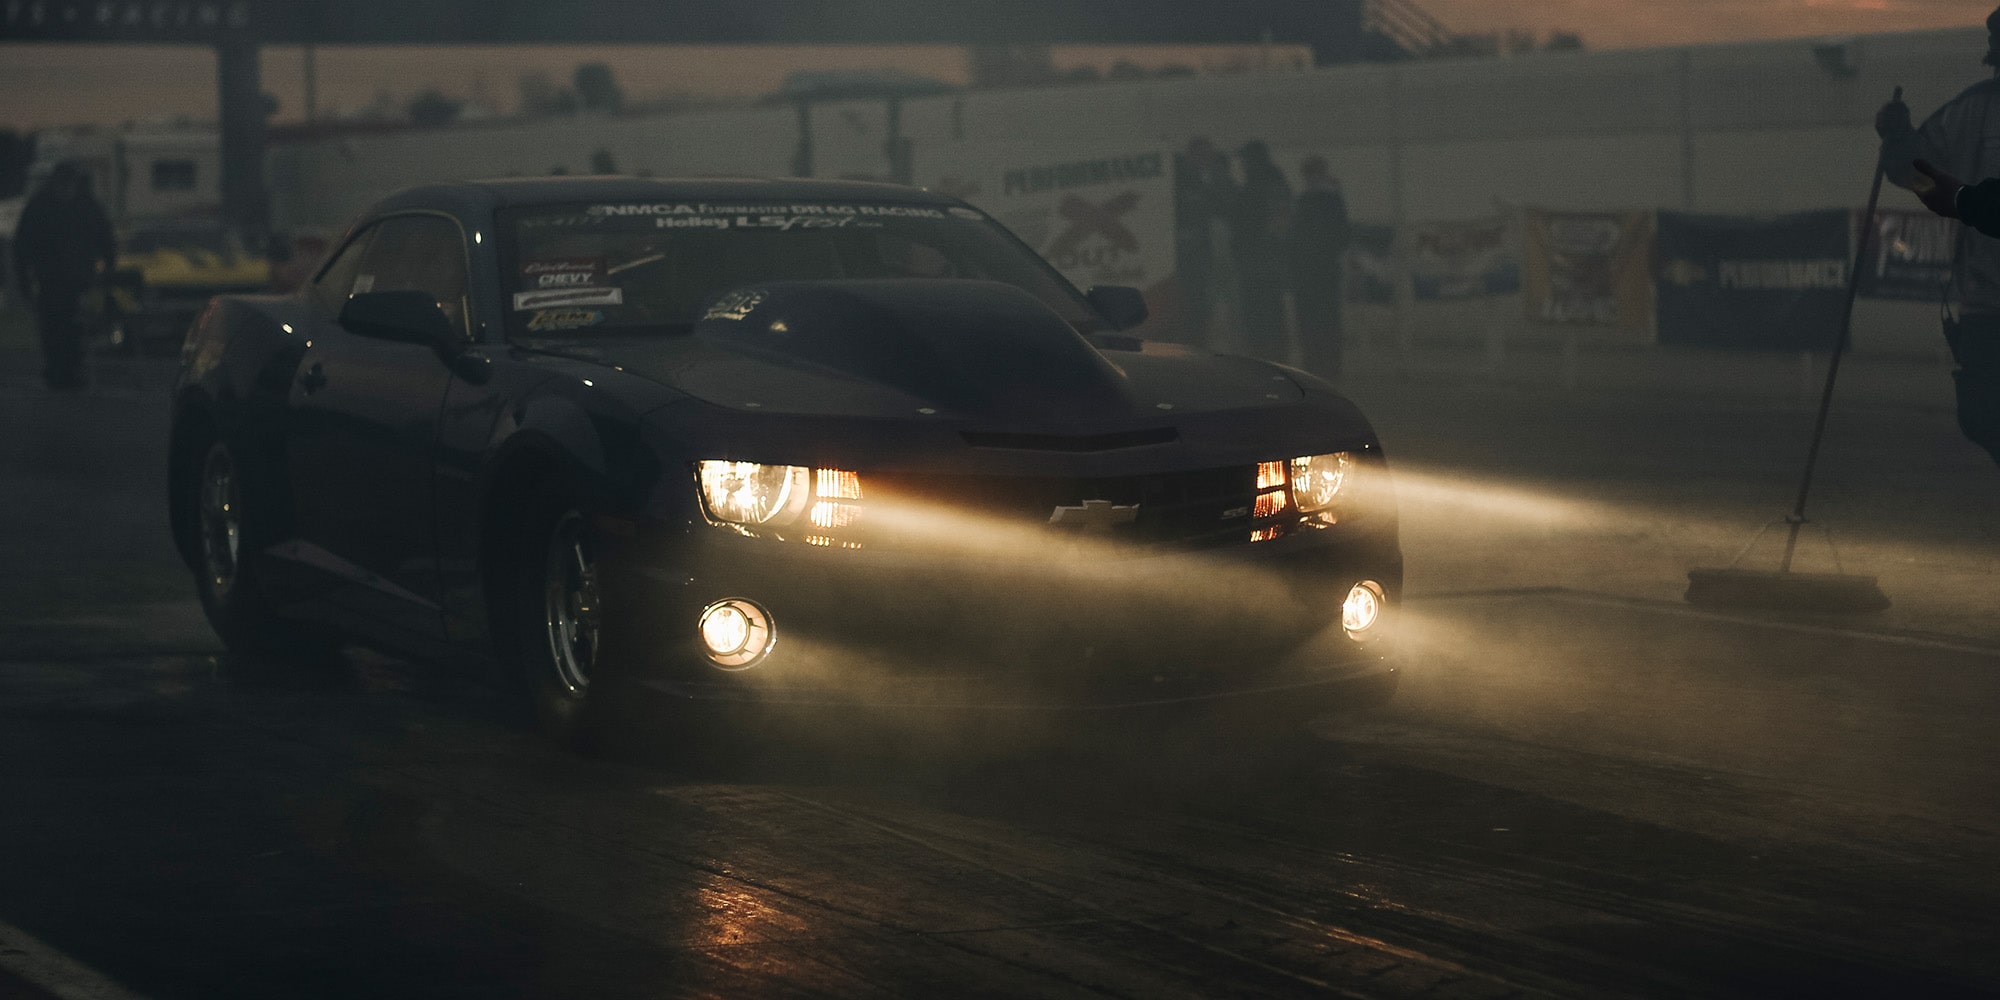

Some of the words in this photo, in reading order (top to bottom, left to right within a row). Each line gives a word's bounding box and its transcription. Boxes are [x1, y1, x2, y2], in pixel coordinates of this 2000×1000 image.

[96, 3, 248, 27] RACING
[1004, 153, 1162, 195] PERFORMANCE
[603, 204, 695, 216] NMCA
[790, 205, 856, 215] DRAG
[857, 207, 945, 219] RACING
[655, 217, 729, 229] Holley
[538, 273, 592, 285] CHEVY
[1719, 259, 1847, 288] PERFORMANCE
